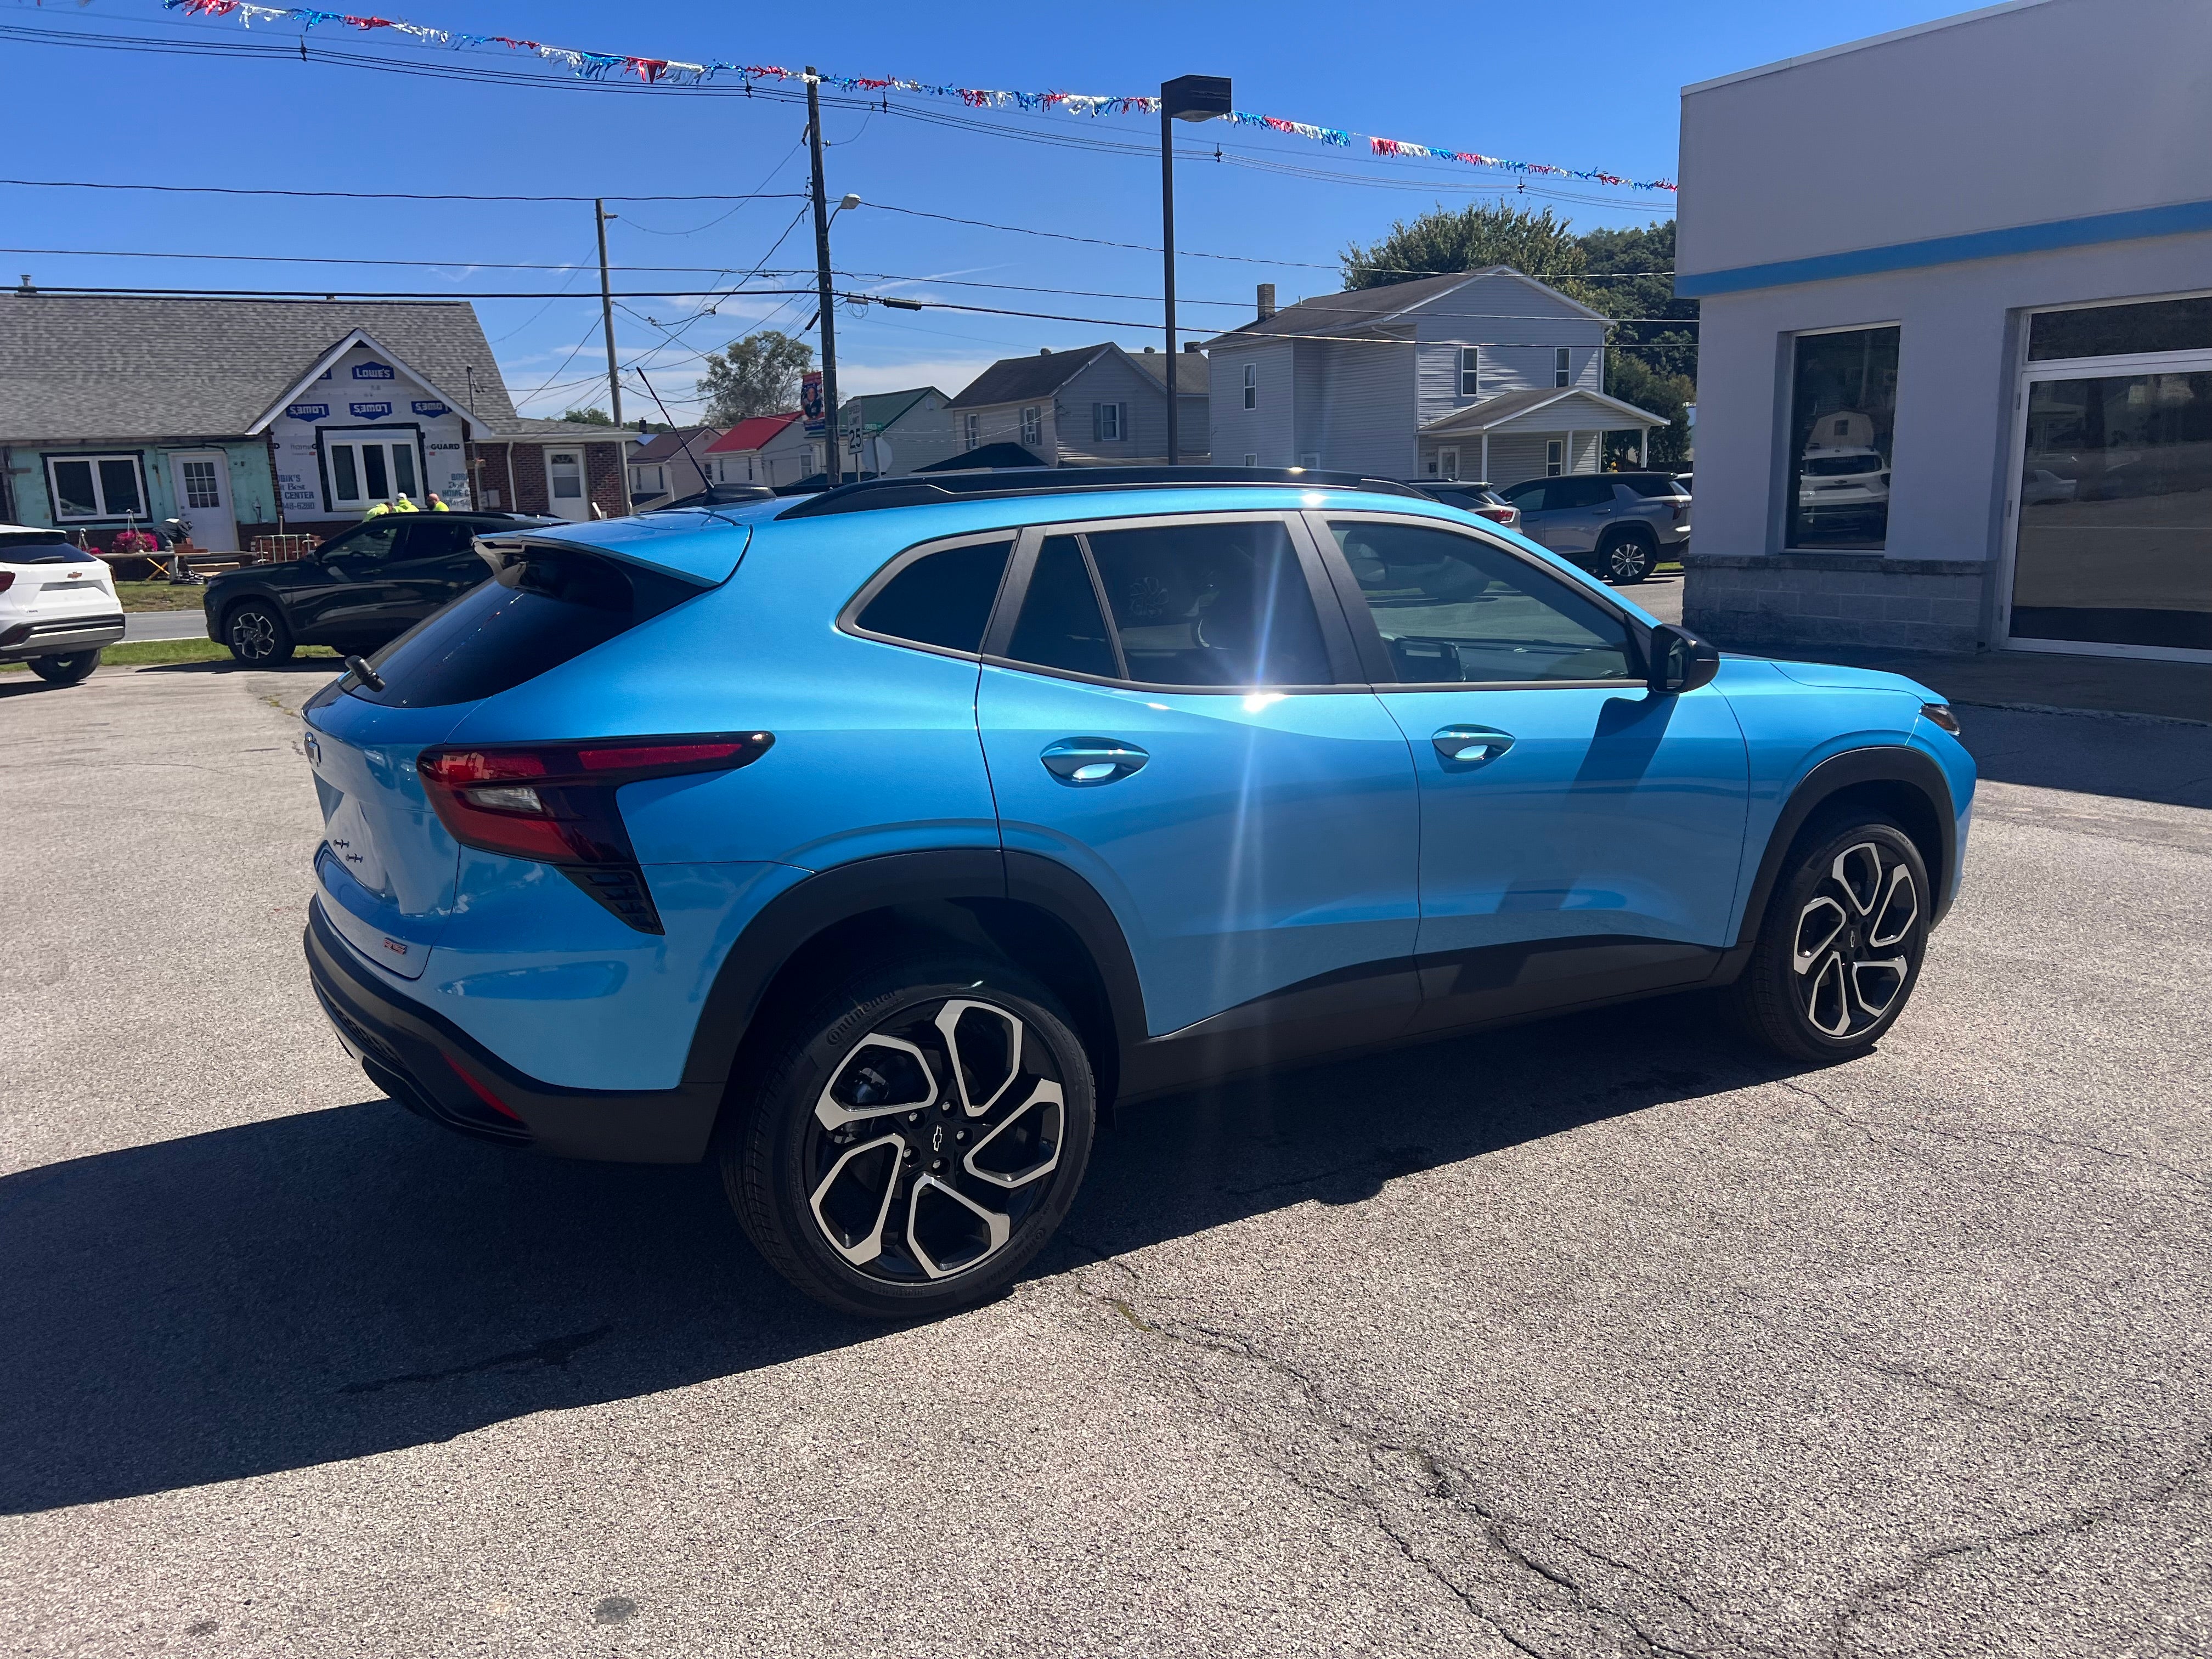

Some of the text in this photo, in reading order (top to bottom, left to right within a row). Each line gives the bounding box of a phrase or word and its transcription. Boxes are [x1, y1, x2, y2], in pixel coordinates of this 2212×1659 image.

[357, 368, 391, 377] LOWE'S
[290, 405, 325, 415] LOWE'S
[354, 403, 388, 413] LOWE'S
[849, 428, 861, 449] 25
[383, 938, 406, 955] RS
